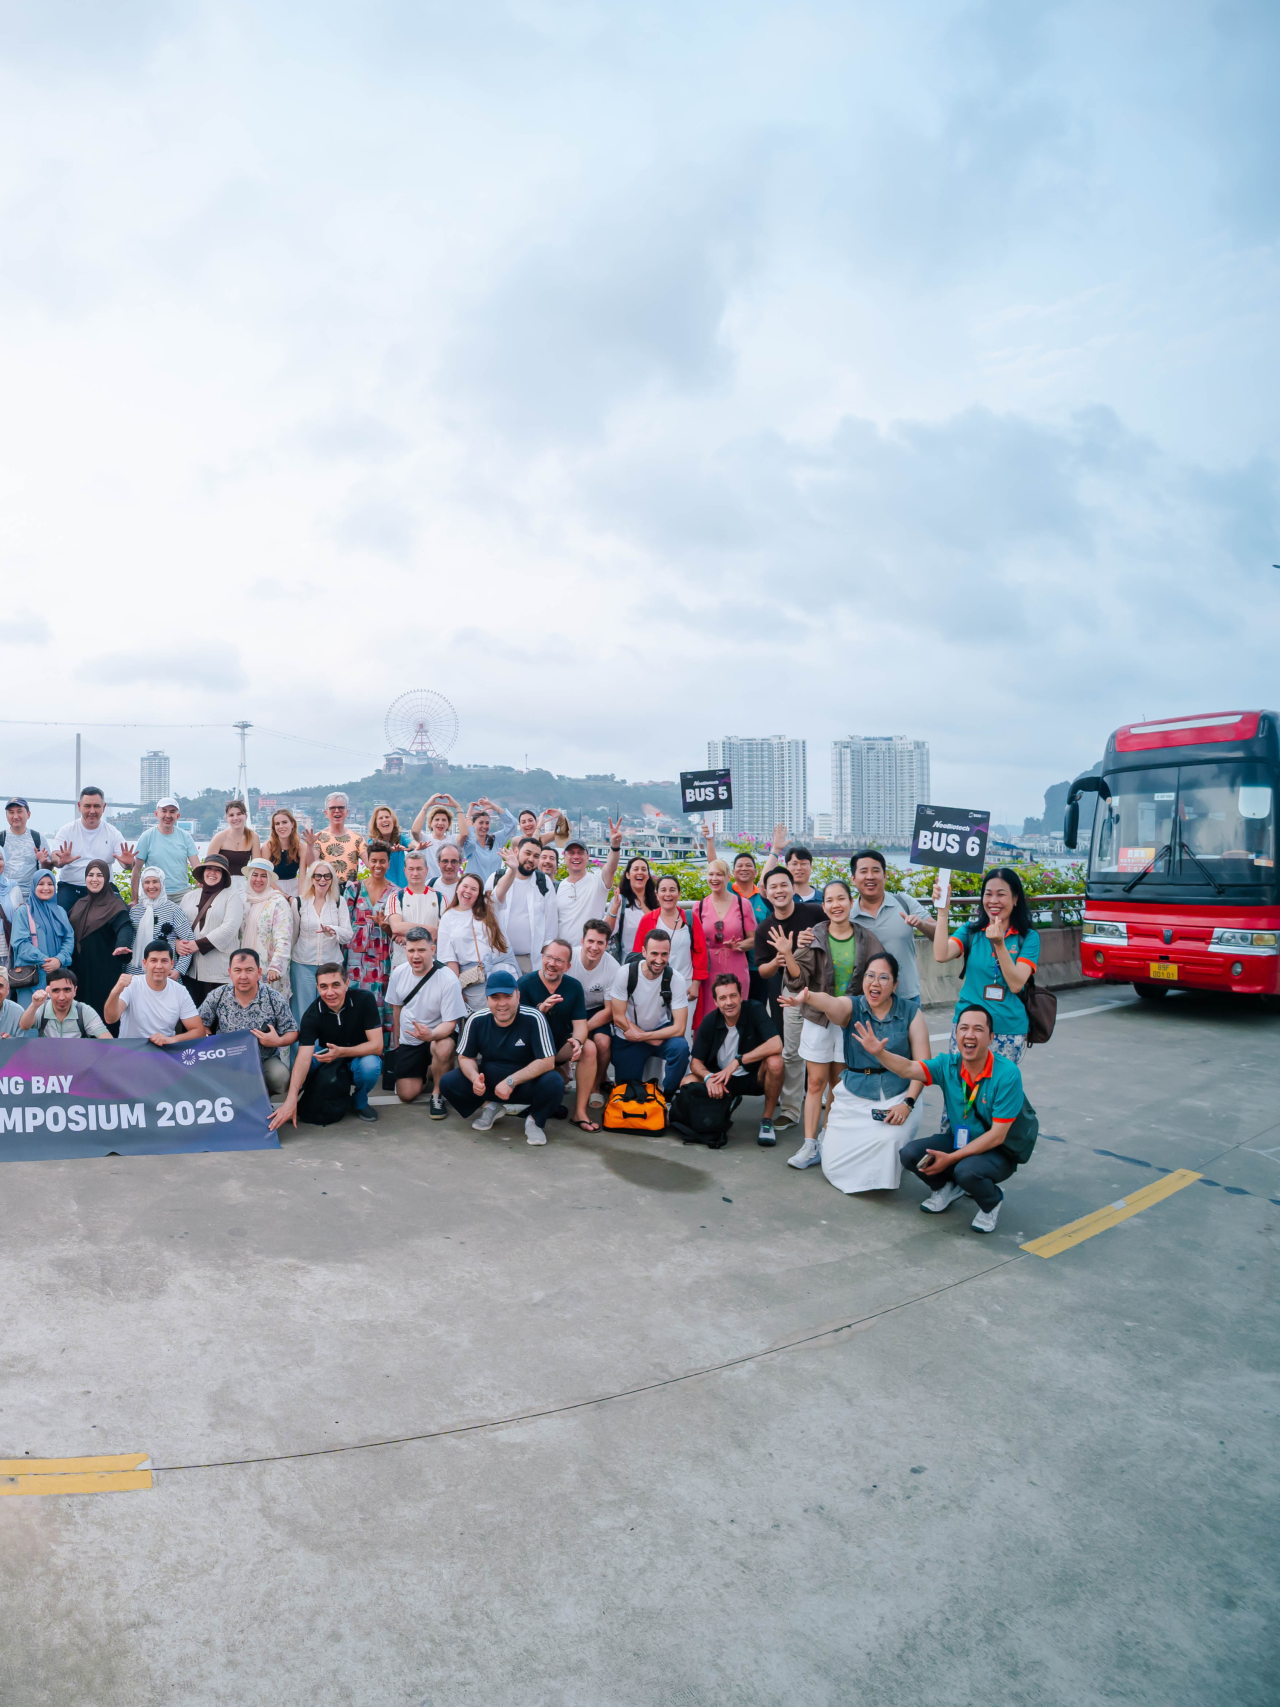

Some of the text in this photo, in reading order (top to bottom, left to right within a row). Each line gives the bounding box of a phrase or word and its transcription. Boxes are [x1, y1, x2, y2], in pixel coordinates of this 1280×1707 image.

[685, 786, 728, 803] BUS 5
[932, 820, 970, 832] NeoBiotech
[917, 830, 981, 857] BUS 6
[197, 1048, 226, 1061] SGO
[31, 1075, 74, 1094] BAY
[156, 1097, 235, 1127] 2026
